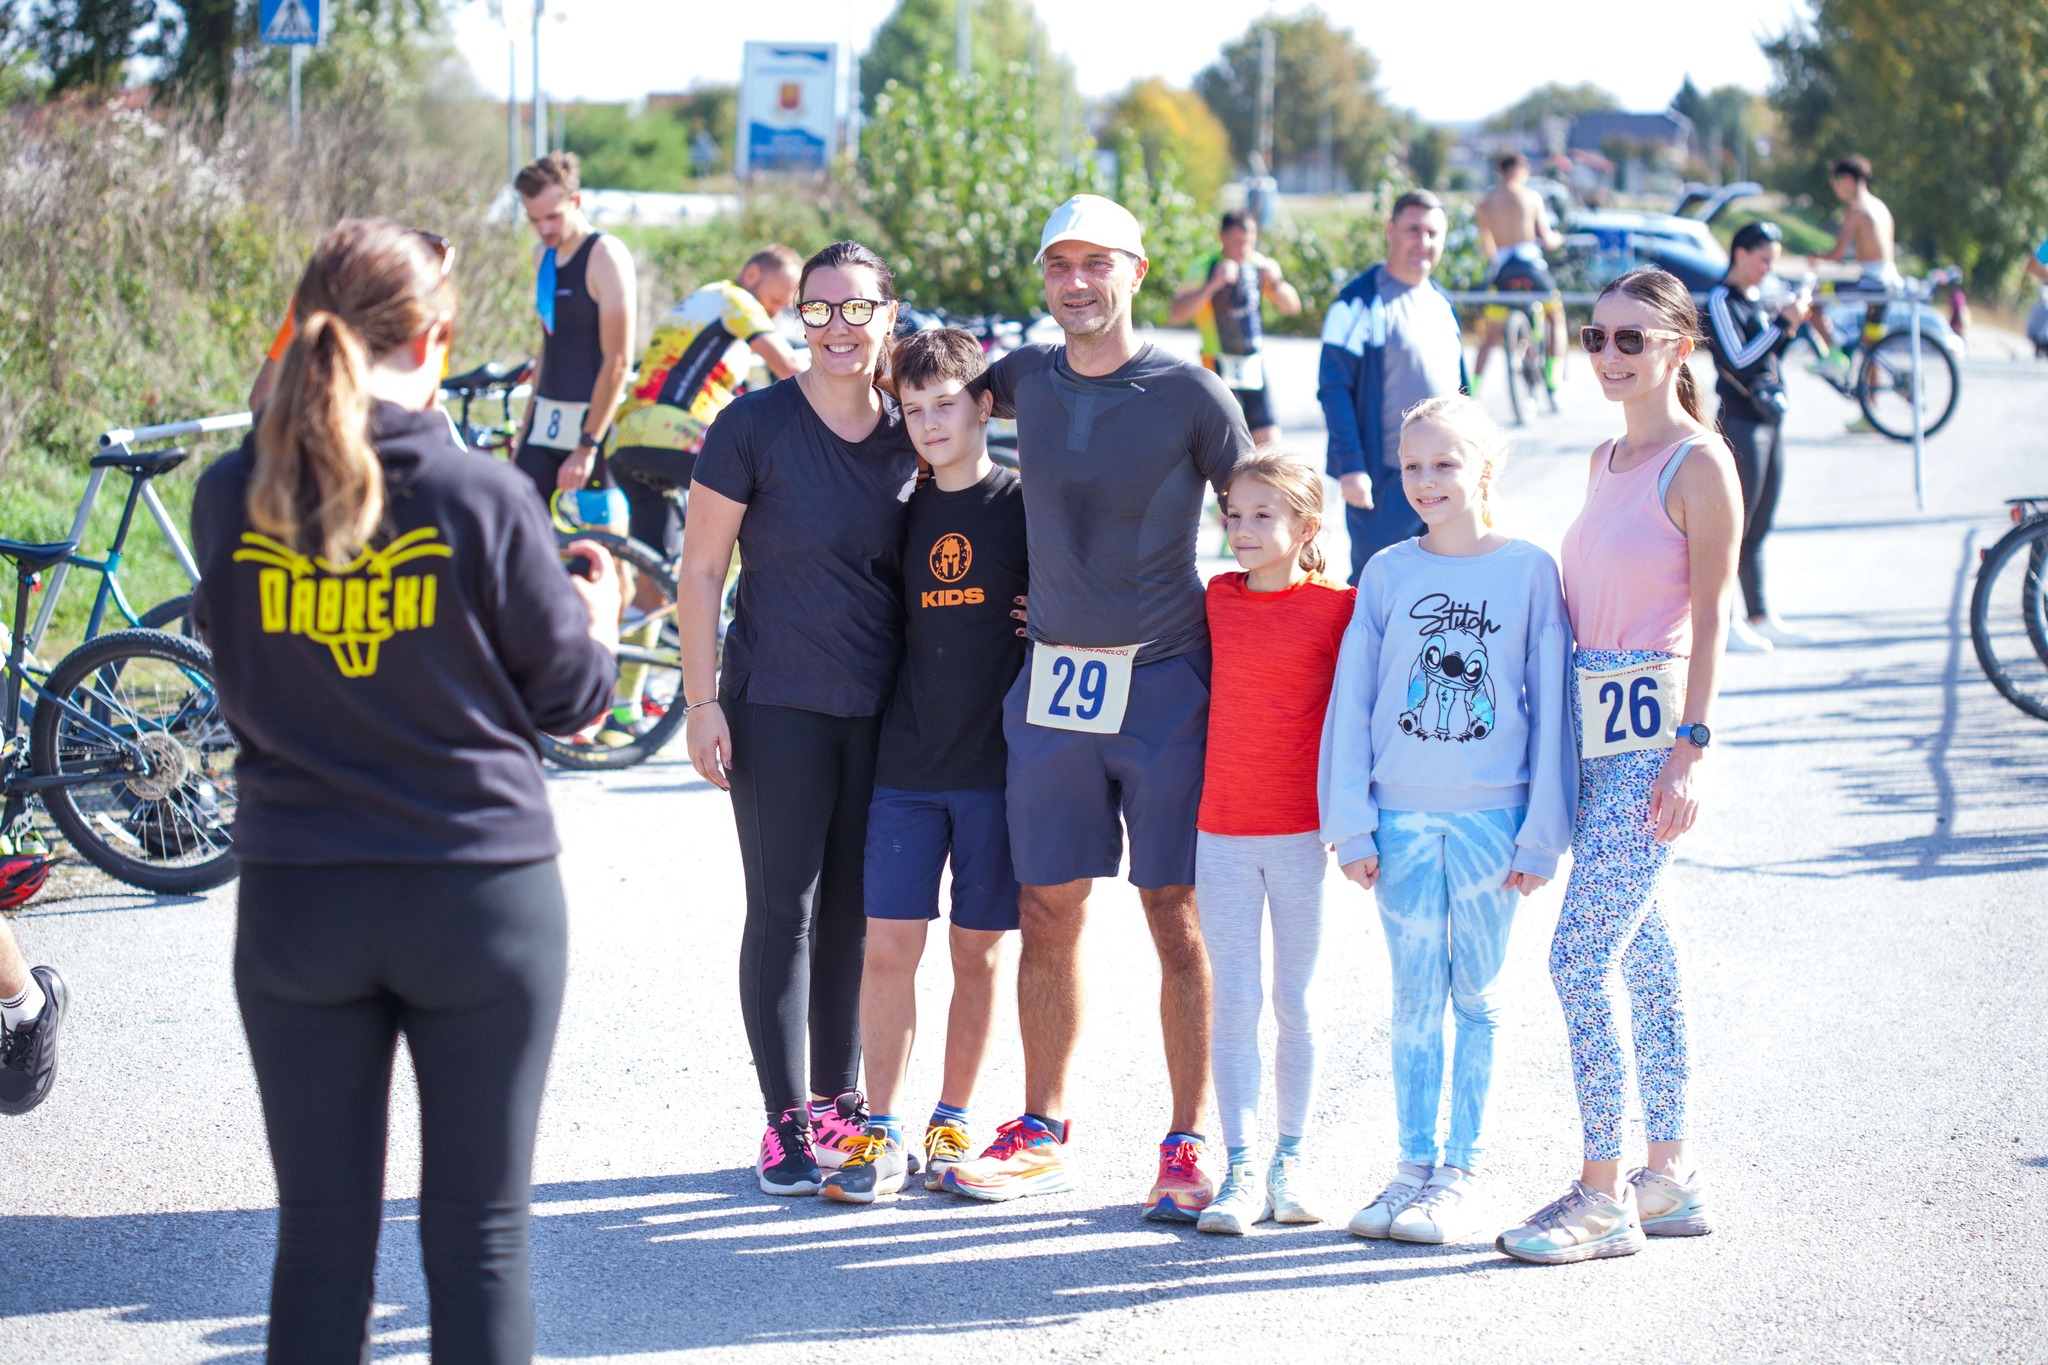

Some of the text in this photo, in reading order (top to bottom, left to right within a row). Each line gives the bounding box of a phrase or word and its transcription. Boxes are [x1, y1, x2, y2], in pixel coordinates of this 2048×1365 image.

[547, 409, 561, 440] 8
[259, 567, 438, 635] DABREKI
[921, 587, 985, 608] KIDS
[1409, 592, 1502, 639] Stitch
[1048, 656, 1107, 720] 29
[1598, 676, 1662, 744] 26
